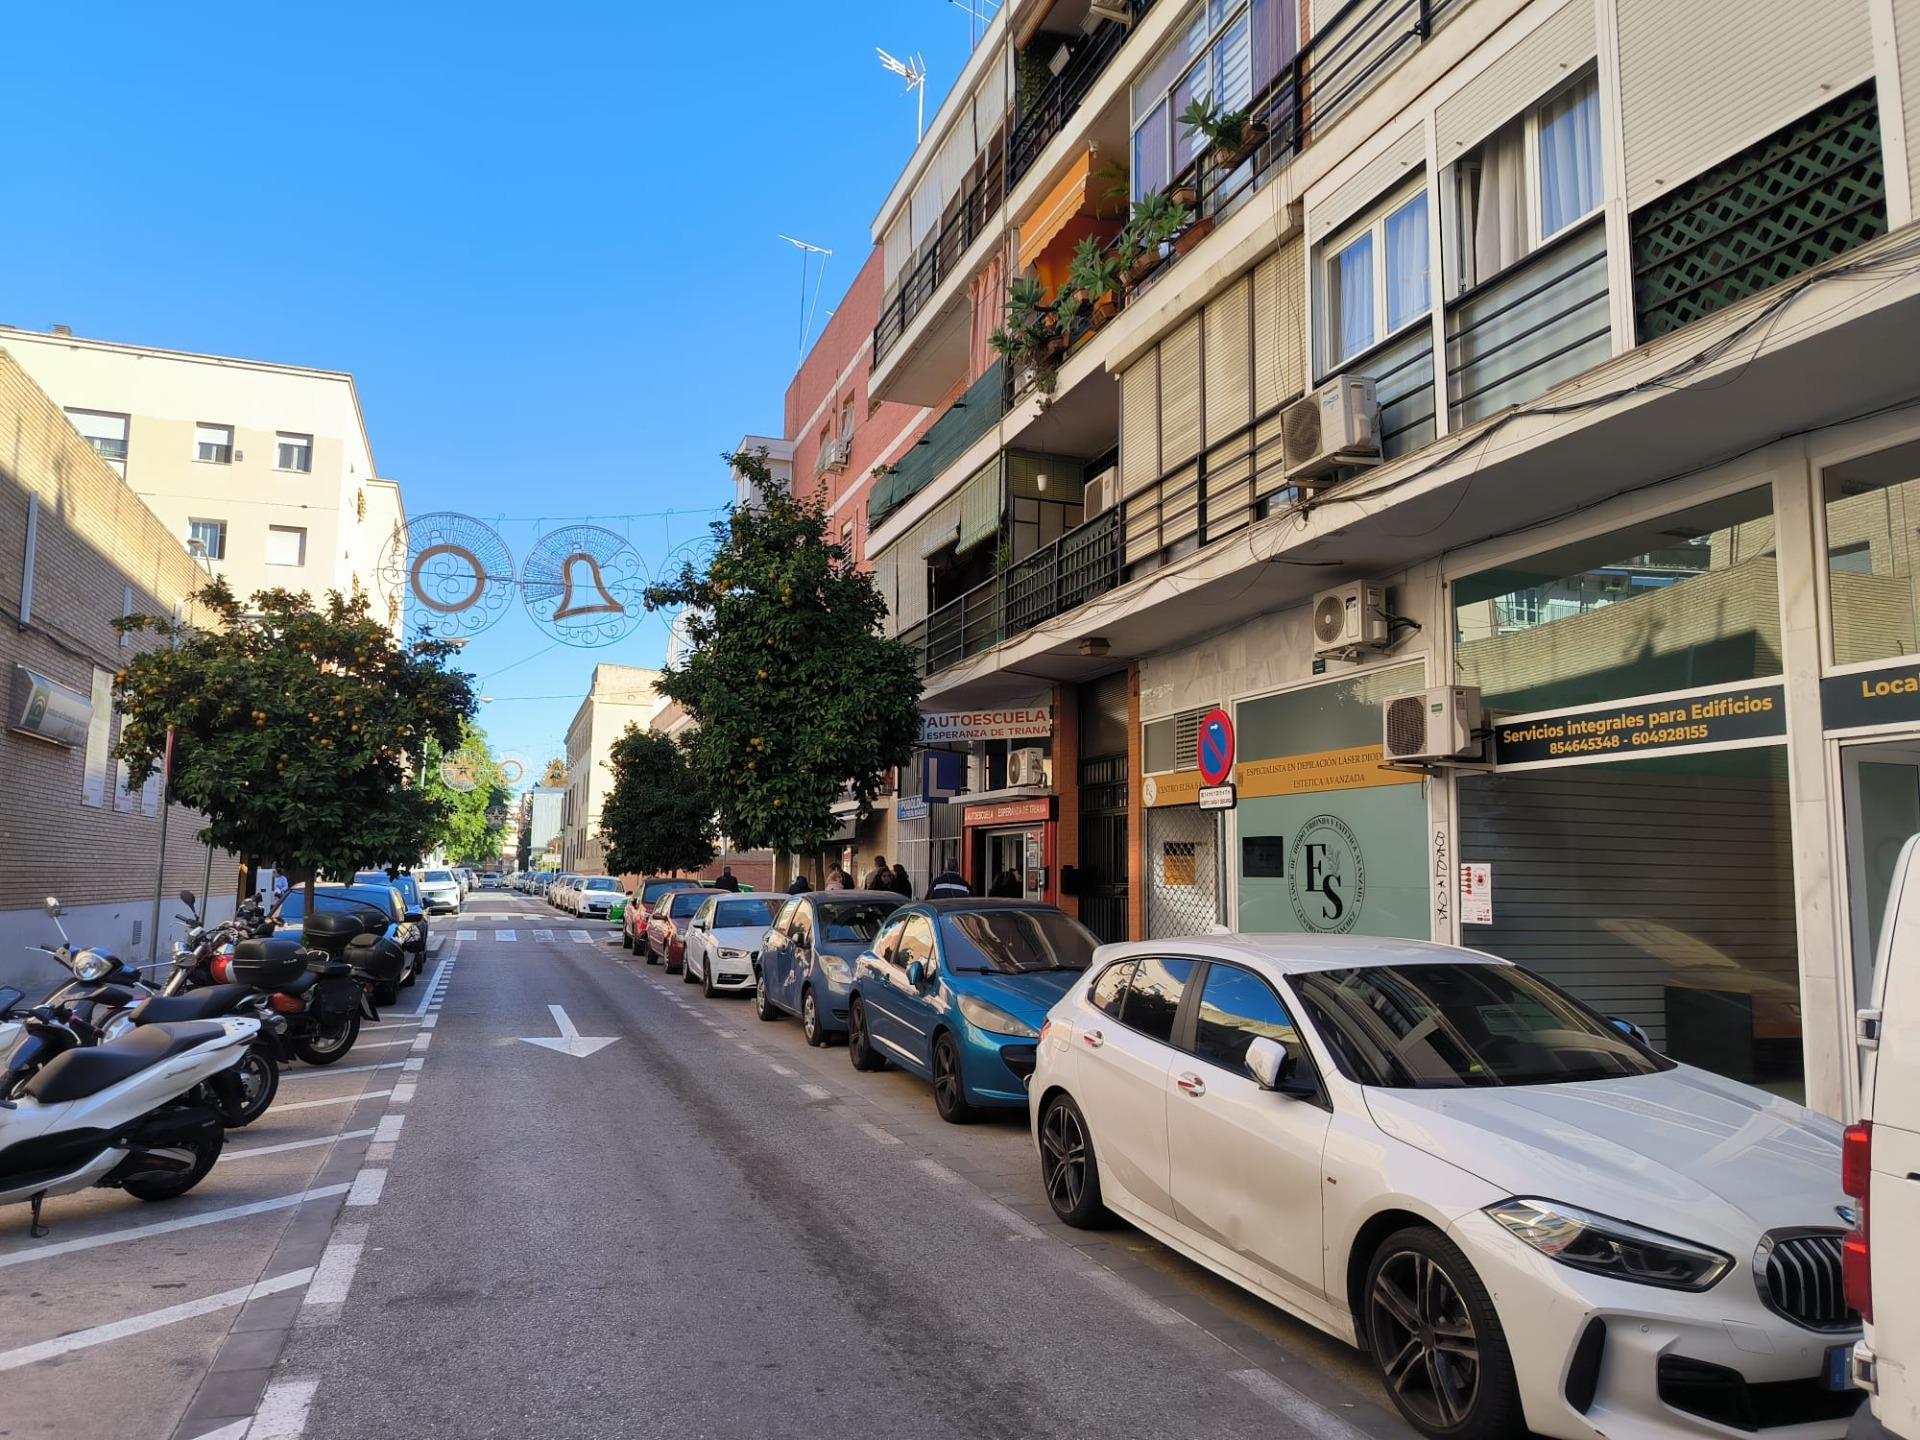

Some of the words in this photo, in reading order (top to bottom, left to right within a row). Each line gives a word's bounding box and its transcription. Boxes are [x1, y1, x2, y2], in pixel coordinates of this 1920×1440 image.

[1862, 672, 1920, 698] Loca
[926, 710, 1047, 729] AUTOESCUELA
[1503, 723, 1564, 744] Servicios
[1567, 713, 1645, 736] integrales
[1648, 708, 1687, 729] para
[1691, 695, 1773, 720] Edificios
[926, 730, 987, 740] ESPERANZA
[991, 728, 1005, 737] DE
[1008, 725, 1049, 736] TRIANA
[1549, 737, 1620, 756] 854645348
[1631, 724, 1709, 746] 604928155
[1288, 762, 1296, 772] EN
[1323, 773, 1365, 786] AVANZADA
